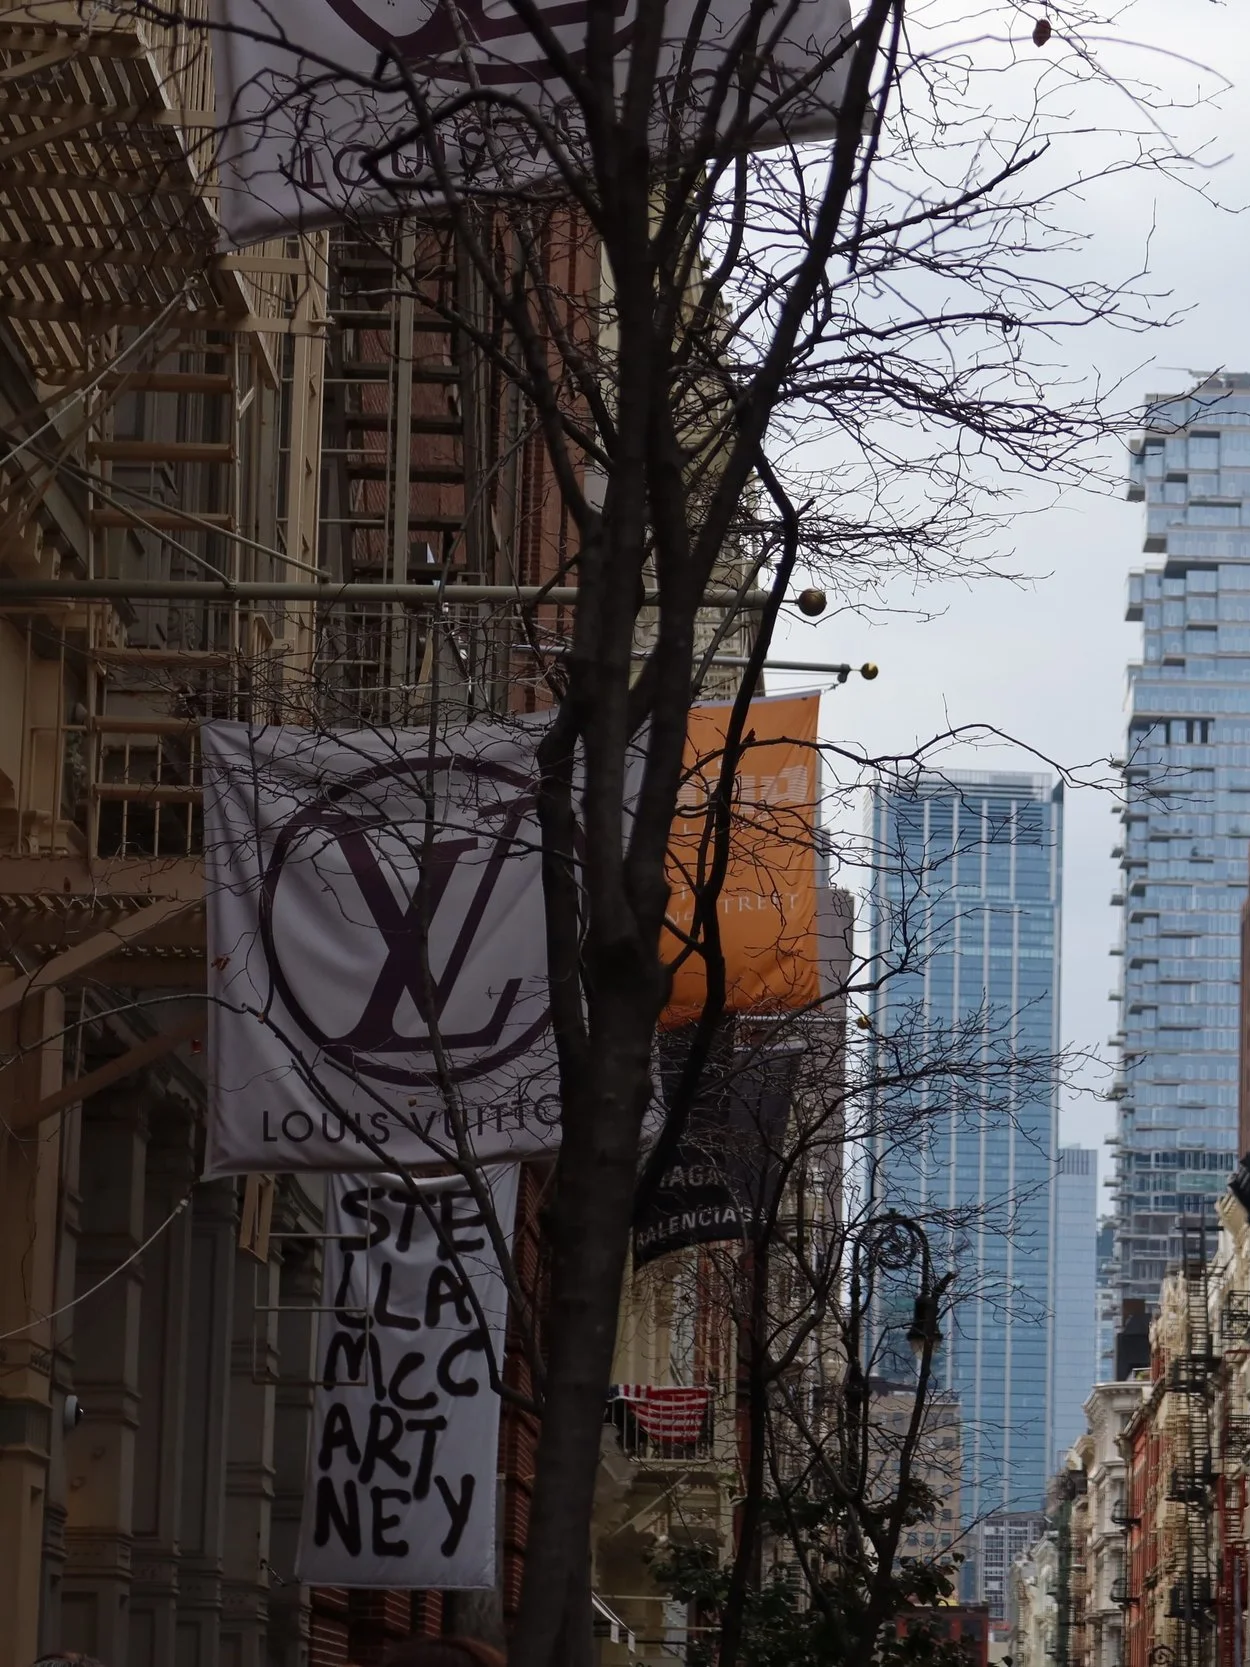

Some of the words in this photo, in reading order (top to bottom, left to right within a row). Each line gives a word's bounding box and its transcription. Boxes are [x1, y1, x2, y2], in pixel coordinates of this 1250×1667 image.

[263, 1110, 390, 1144] LOUIS
[410, 1093, 562, 1140] VUITTO
[340, 1187, 486, 1261] STE
[335, 1253, 472, 1330] LLA
[324, 1329, 486, 1410] MCC
[318, 1403, 447, 1501] ART
[314, 1474, 475, 1557] NEY
